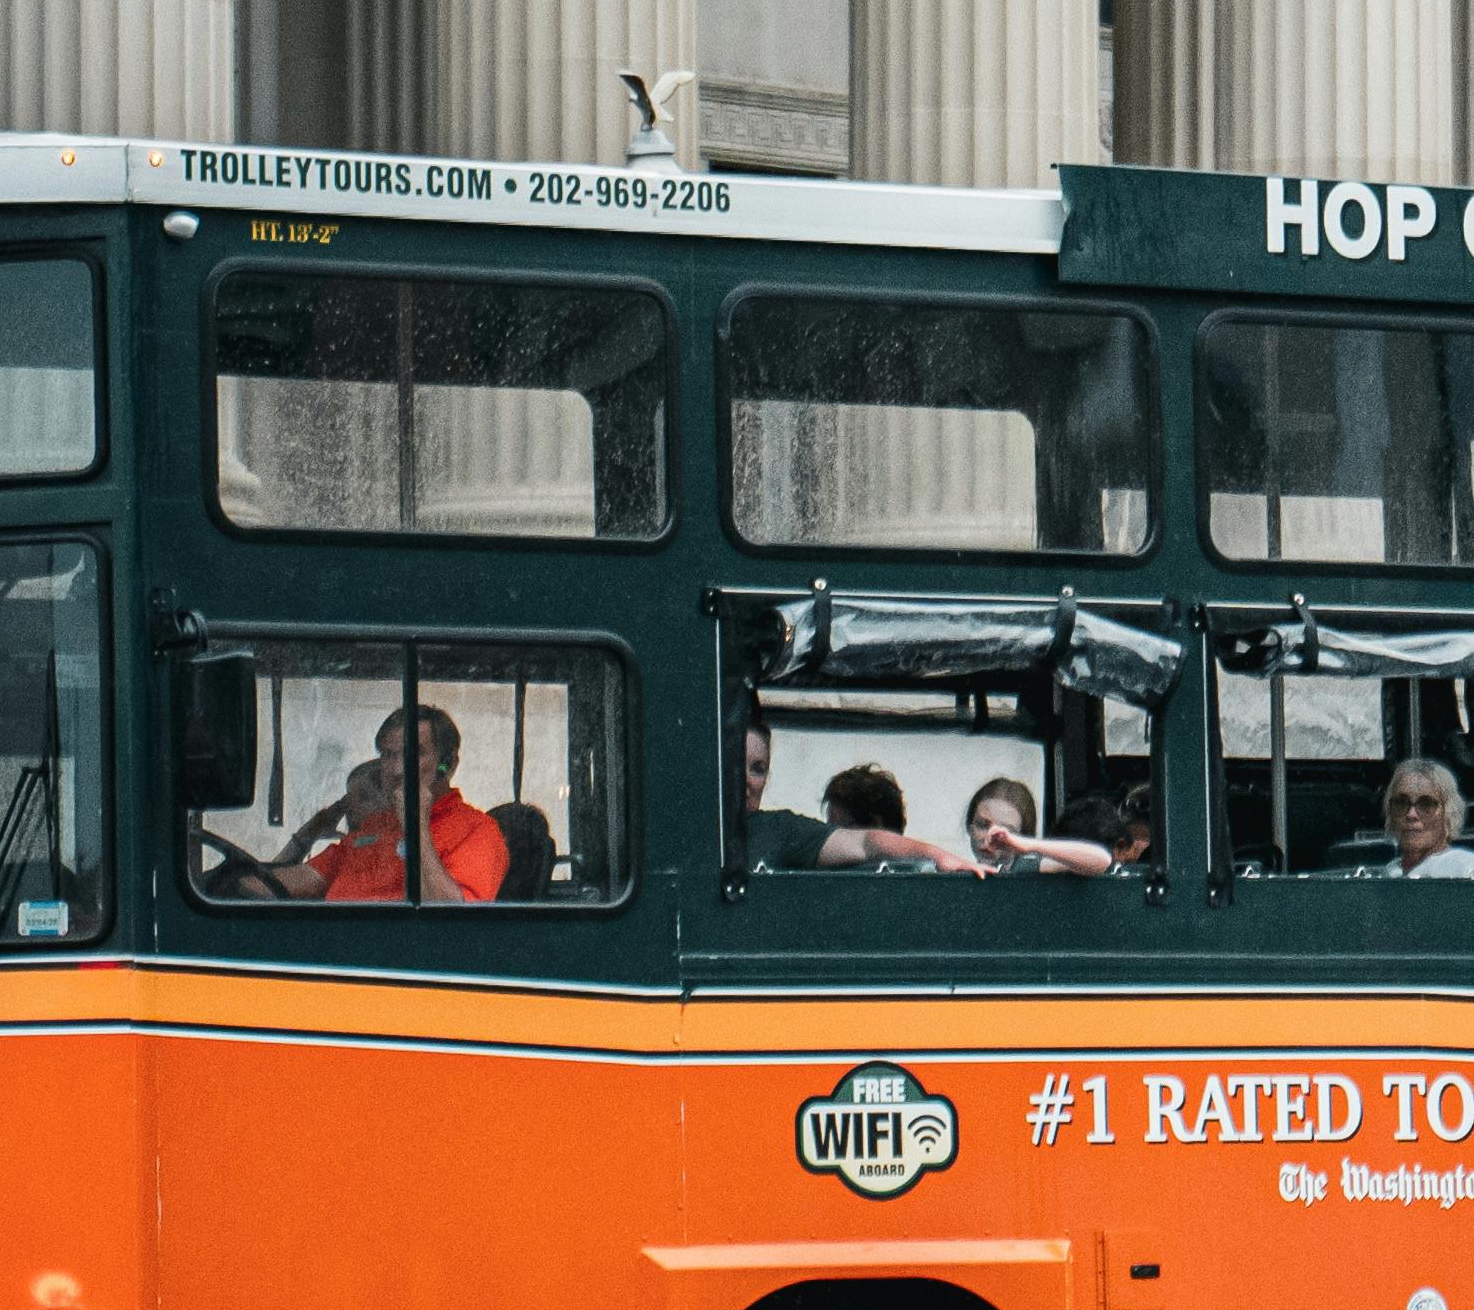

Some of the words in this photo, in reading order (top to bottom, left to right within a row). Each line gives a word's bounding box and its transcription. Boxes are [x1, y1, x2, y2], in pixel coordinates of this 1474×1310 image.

[180, 149, 492, 201] TROLLEYTOURS.COM
[529, 172, 731, 214] 202-969-2206
[251, 220, 284, 242] HT.
[1266, 177, 1437, 261] HOP
[853, 1077, 906, 1103] FREE
[1026, 1073, 1116, 1145] #1
[1142, 1074, 1363, 1144] RATED
[810, 1112, 903, 1160] WIFI
[858, 1163, 905, 1177] ABOARD
[1278, 1162, 1327, 1207] The
